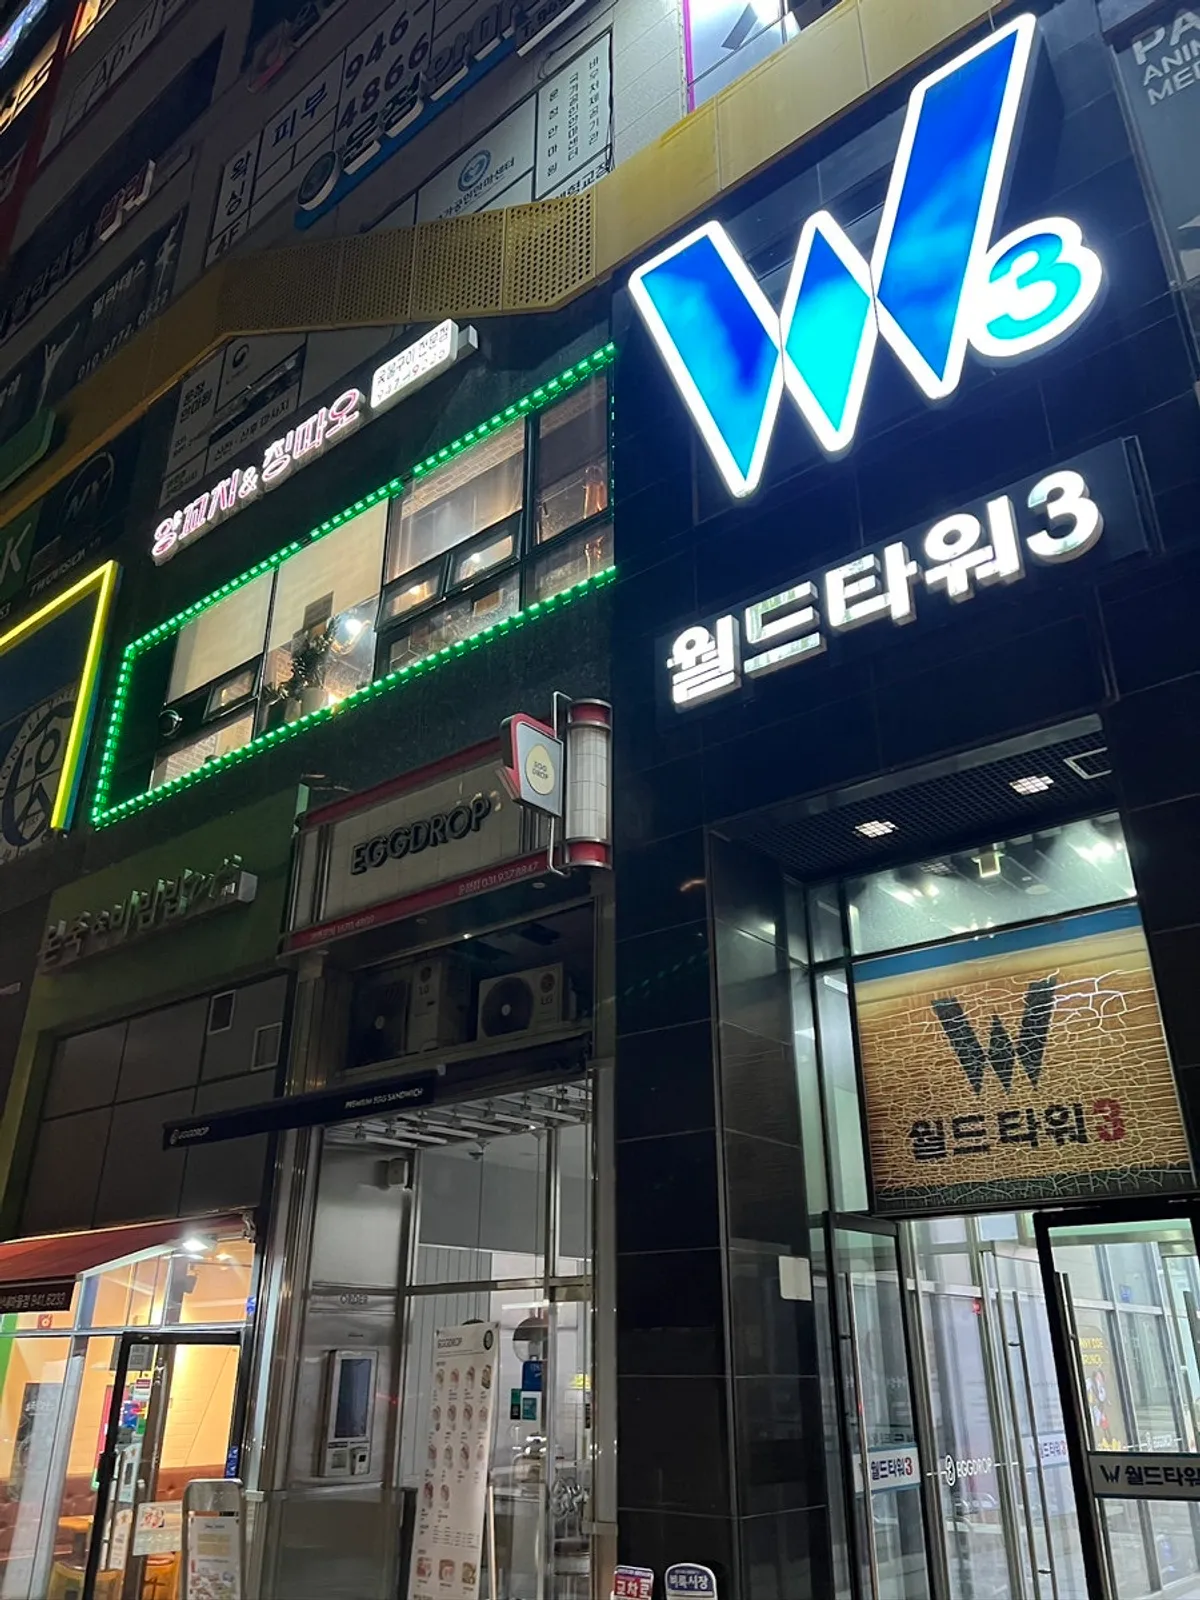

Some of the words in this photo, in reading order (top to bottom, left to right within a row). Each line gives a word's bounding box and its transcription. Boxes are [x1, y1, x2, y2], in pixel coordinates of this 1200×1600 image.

[271, 82, 327, 147] 피부
[337, 31, 431, 132] 4866
[215, 223, 238, 257] 4F
[666, 470, 1105, 706] 월드타워3
[351, 797, 491, 876] EGGDROP
[930, 975, 1057, 1097] W
[909, 1099, 1126, 1162] 월드타워3
[870, 1456, 913, 1482] 월드타워3
